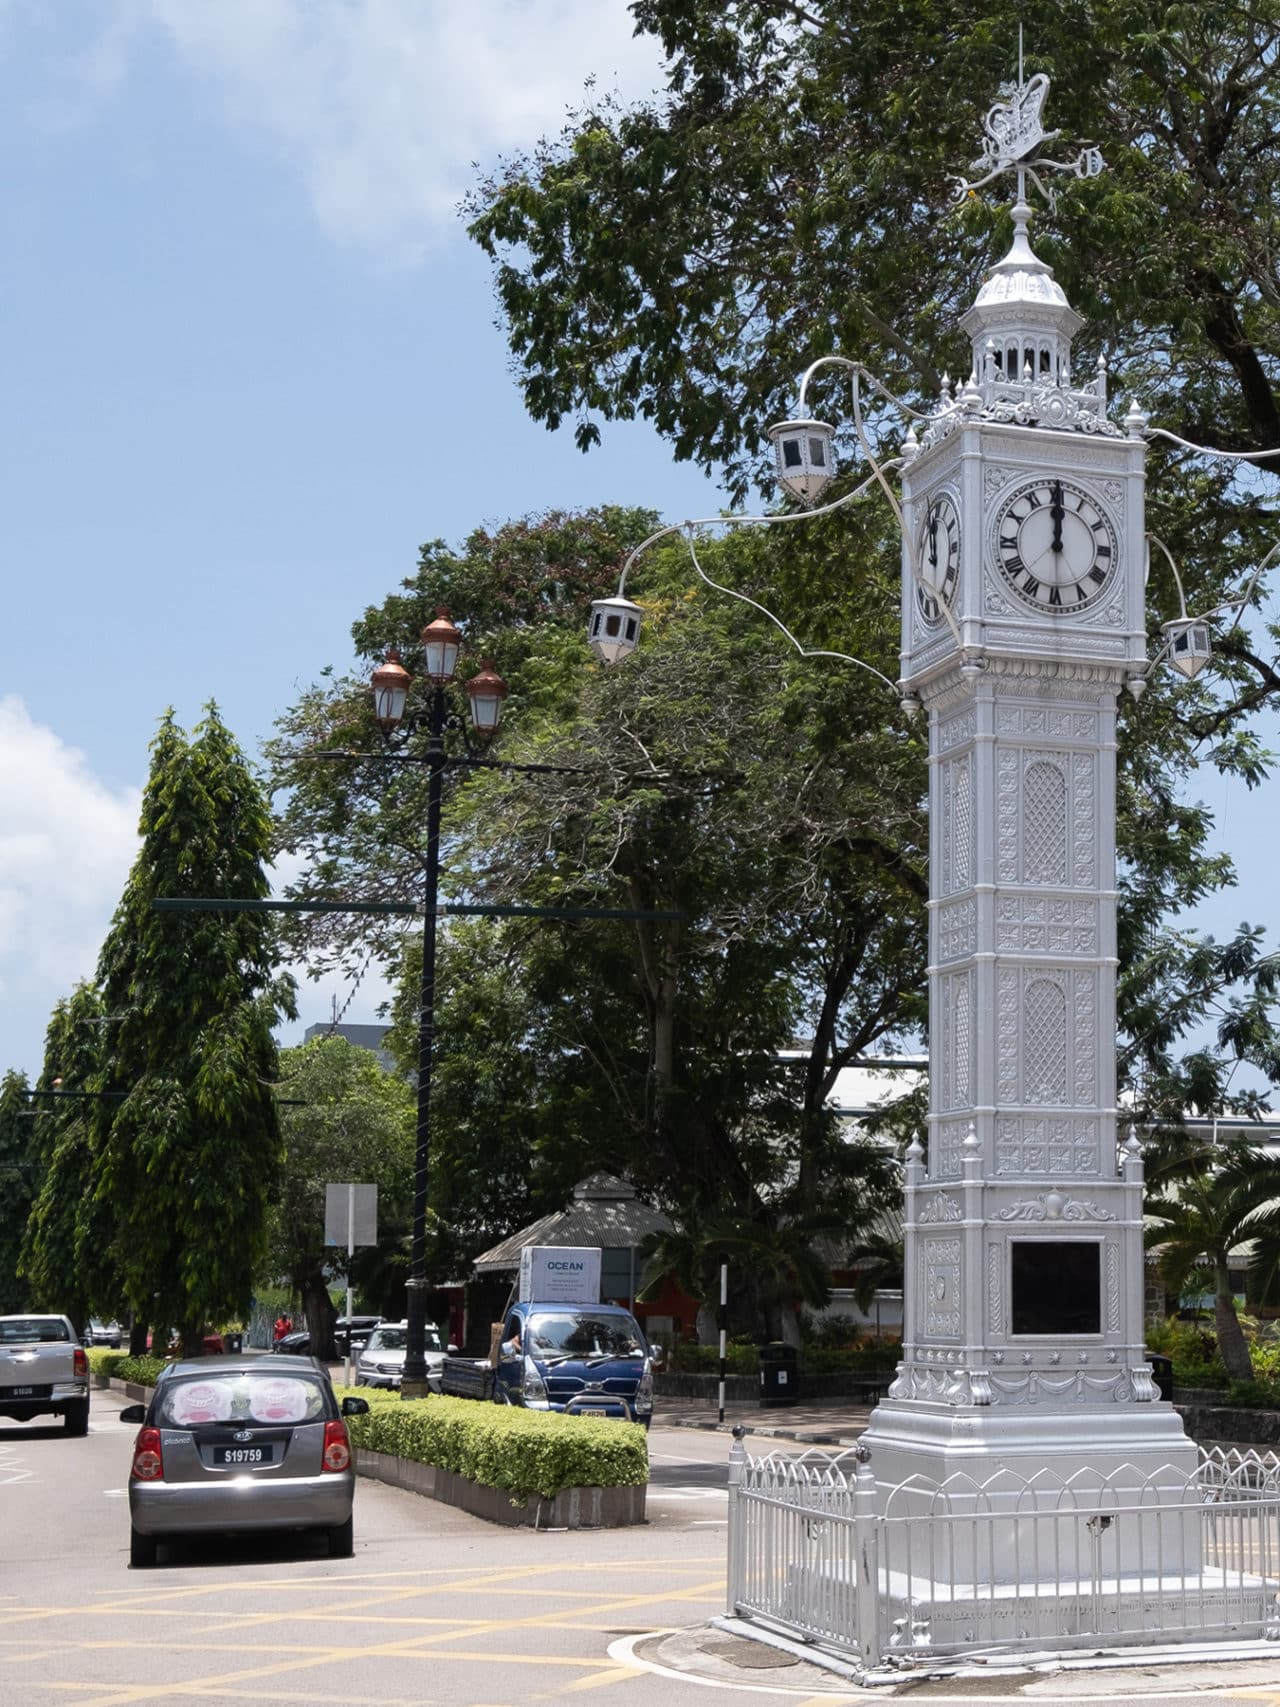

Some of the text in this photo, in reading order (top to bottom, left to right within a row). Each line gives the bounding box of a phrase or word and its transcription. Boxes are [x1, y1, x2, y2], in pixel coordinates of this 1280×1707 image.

[1049, 487, 1064, 506] XI
[547, 1261, 583, 1271] OCEAN
[224, 1449, 262, 1462] S19759
